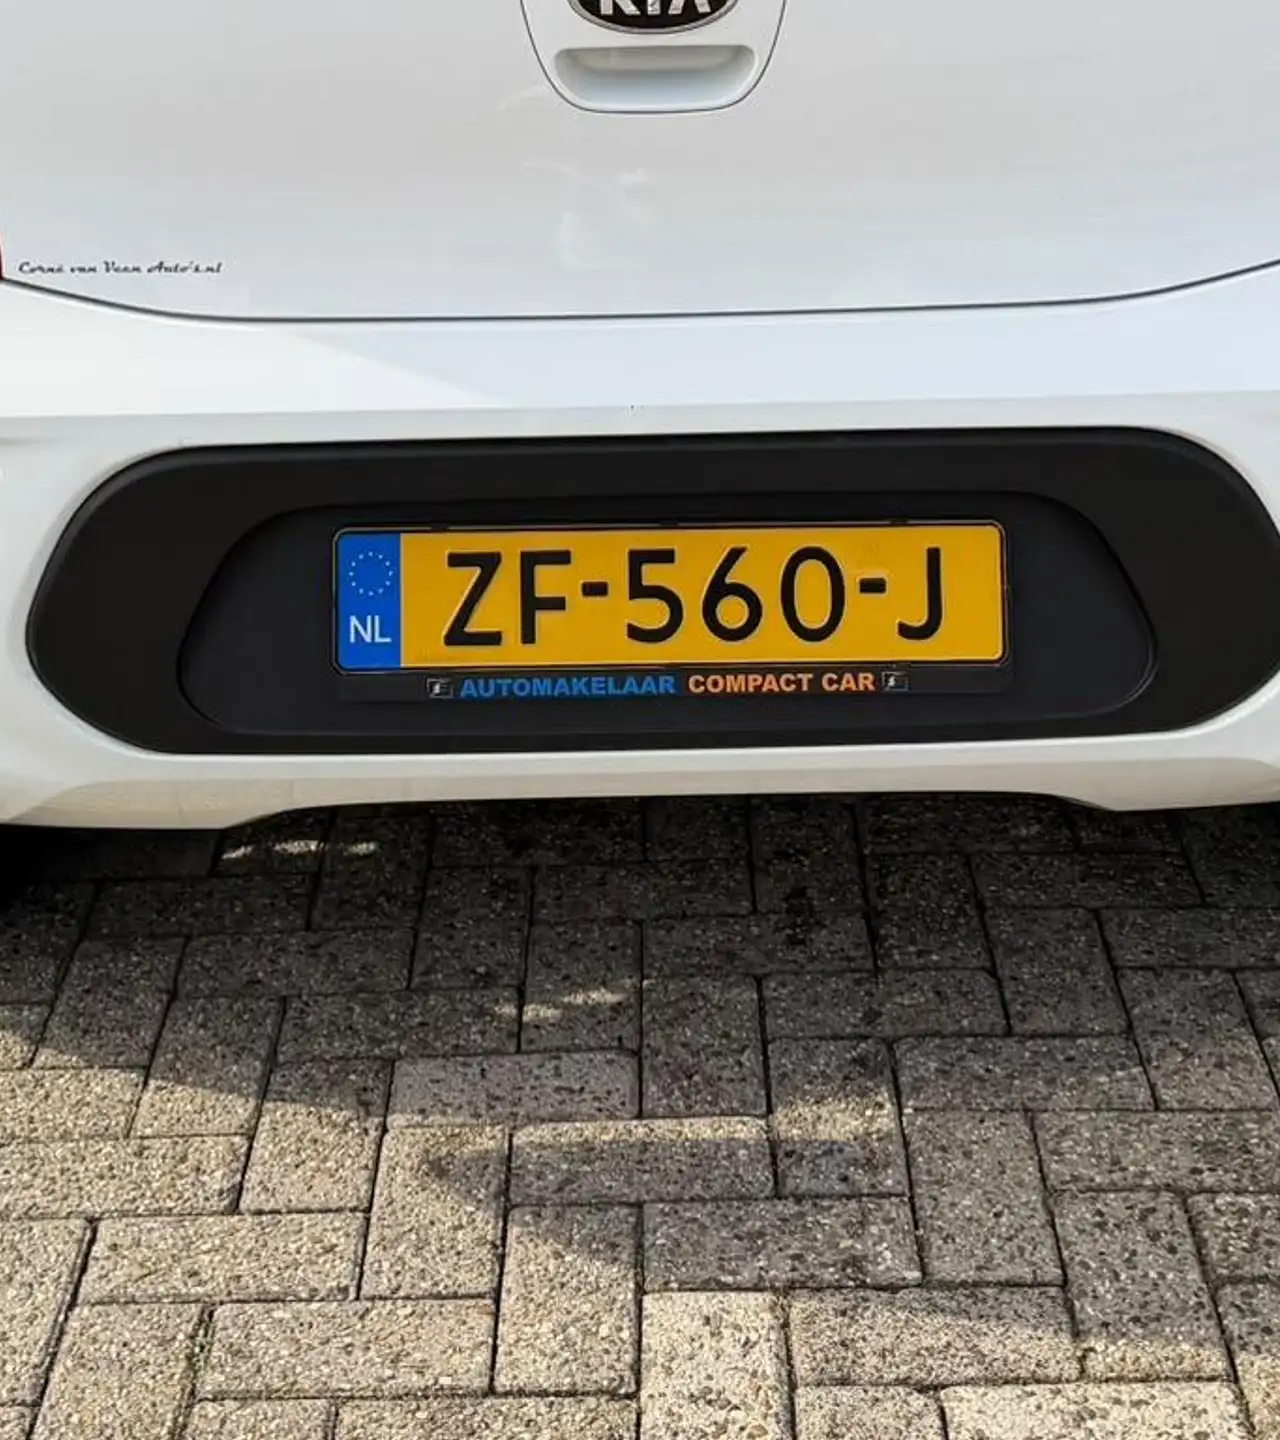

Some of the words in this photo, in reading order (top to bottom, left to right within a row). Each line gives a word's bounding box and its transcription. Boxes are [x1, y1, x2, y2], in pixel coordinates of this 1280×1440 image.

[442, 546, 943, 648] ZF-560-J
[349, 616, 391, 644] NL
[459, 675, 677, 698] AUTOMAKELAAR
[687, 673, 815, 694] COMPACT
[821, 672, 875, 693] CAR
